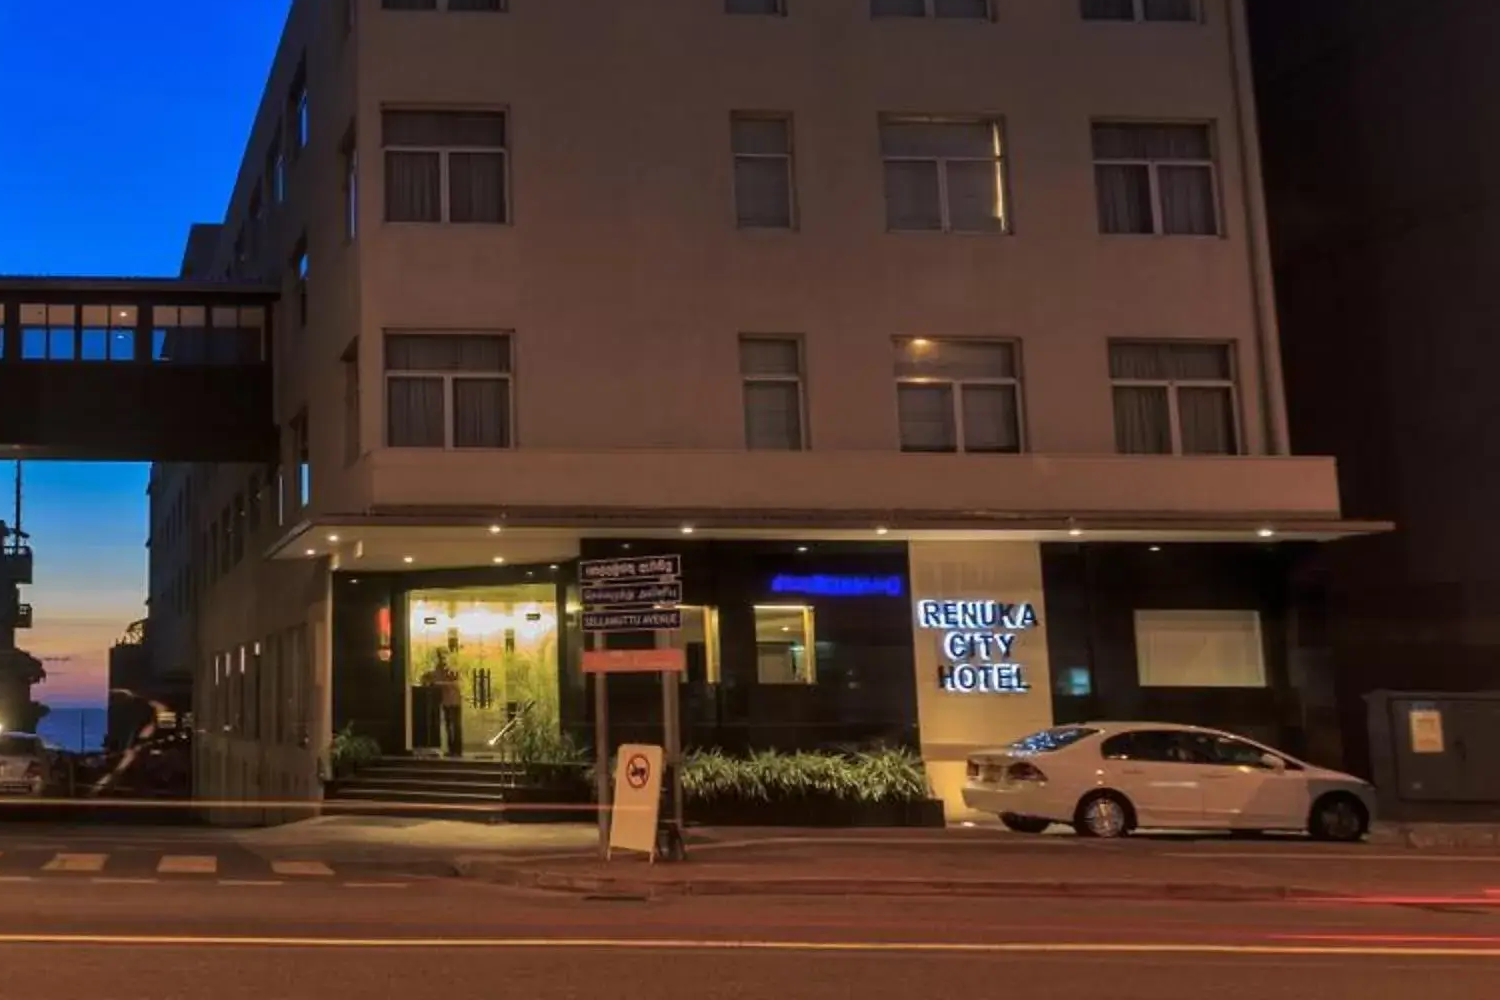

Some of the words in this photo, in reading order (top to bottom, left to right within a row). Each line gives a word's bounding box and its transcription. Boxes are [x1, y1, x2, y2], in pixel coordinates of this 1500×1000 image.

[918, 599, 1038, 629] RENUKA
[943, 631, 1016, 661] CITY
[937, 663, 1032, 693] HOTEL
